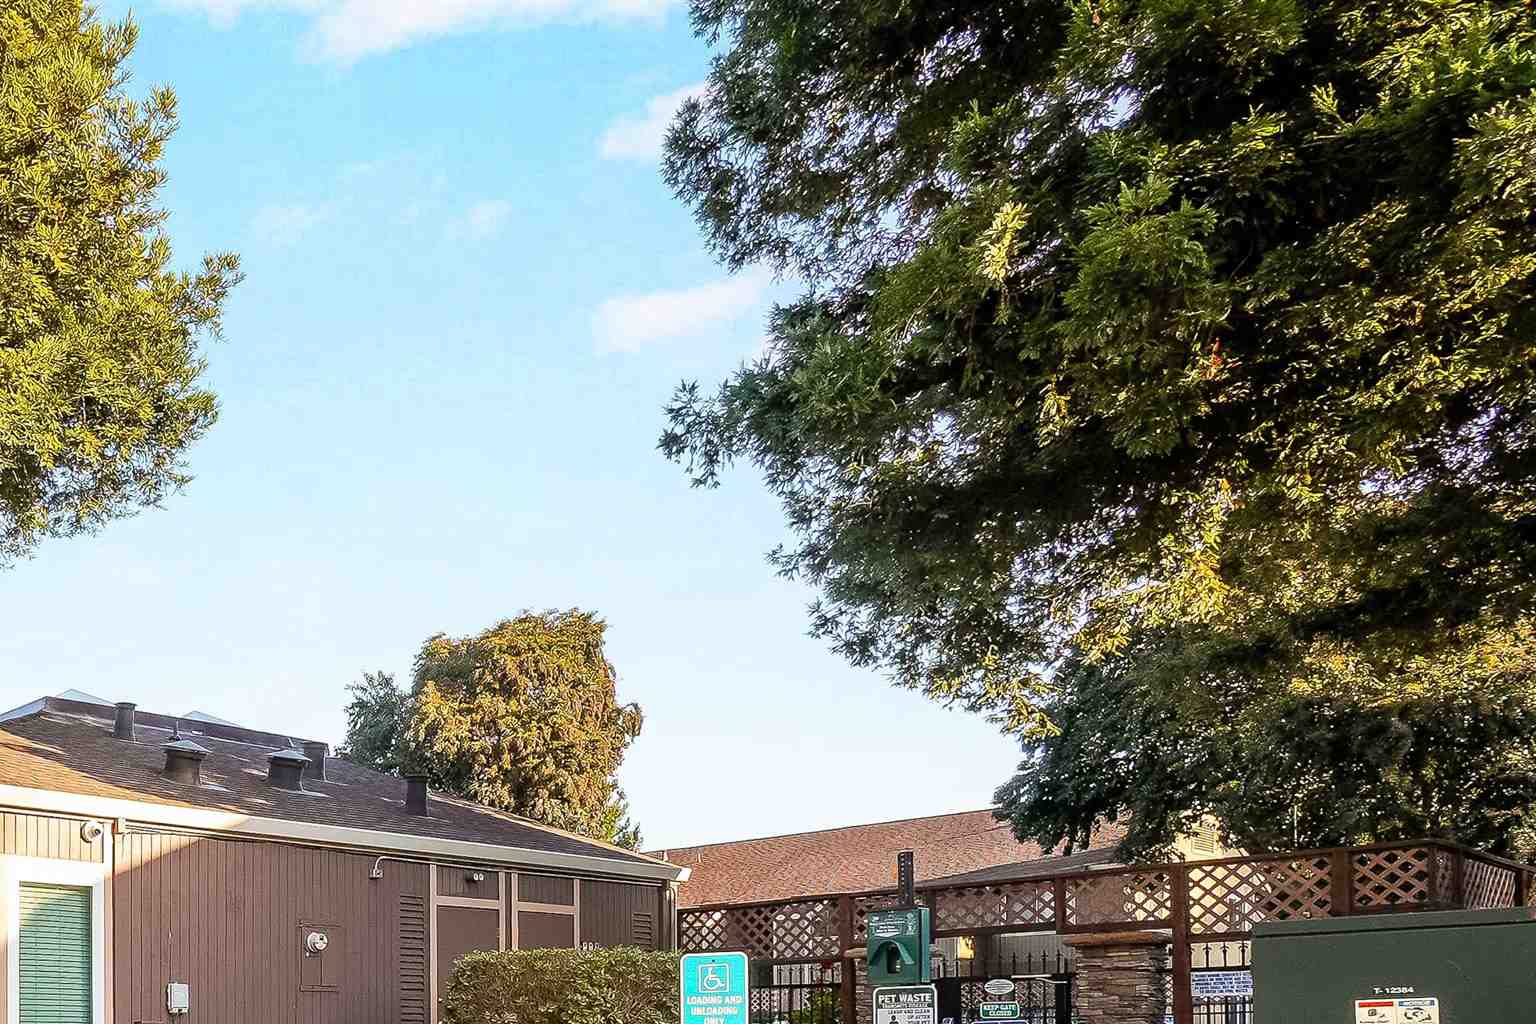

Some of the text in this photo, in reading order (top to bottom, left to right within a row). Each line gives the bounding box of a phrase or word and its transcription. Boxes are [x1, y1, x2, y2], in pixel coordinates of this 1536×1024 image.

[687, 995, 743, 1005] LOADING AND
[879, 993, 932, 1003] PET WASTE
[691, 1007, 738, 1016] UNLOADING
